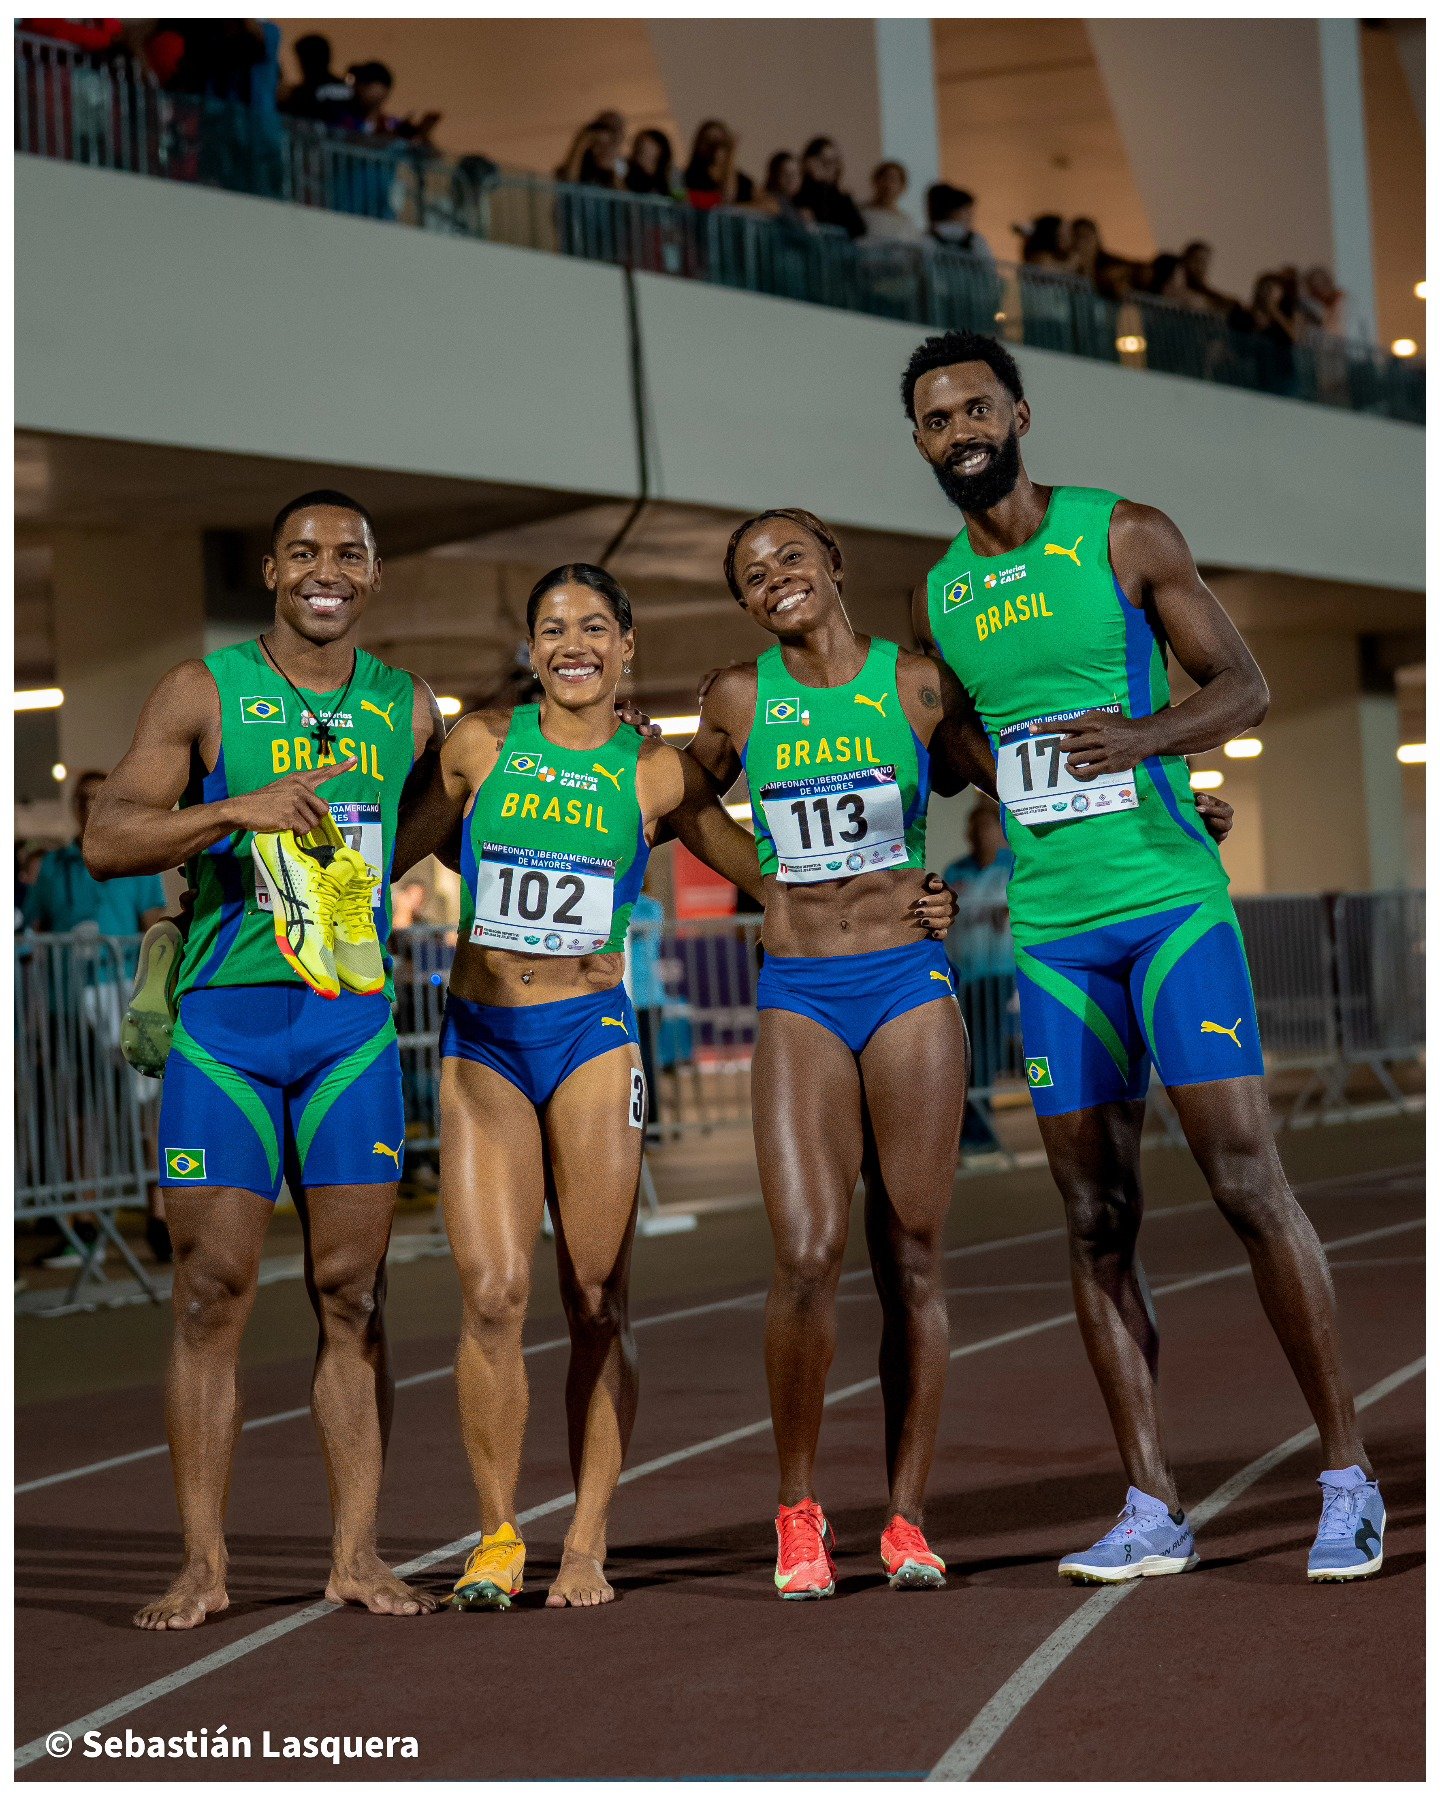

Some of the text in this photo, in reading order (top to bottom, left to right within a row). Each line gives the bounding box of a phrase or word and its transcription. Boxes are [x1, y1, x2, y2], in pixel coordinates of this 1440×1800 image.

[999, 564, 1026, 577] loterias
[1000, 570, 1027, 584] CAIXA
[975, 592, 1053, 641] BRASIL
[776, 736, 880, 770] BRASIL
[1016, 736, 1096, 791] 17
[560, 778, 597, 791] CAIXA
[561, 769, 598, 783] loterias
[800, 782, 854, 796] DE MAYORES
[501, 792, 608, 834] BRASIL
[791, 793, 868, 849] 113
[483, 842, 613, 867] CAMPEONATO IBEROAMERICANO
[518, 857, 572, 870] DE MAYORES
[499, 867, 585, 925] 102
[633, 1074, 643, 1122] 3
